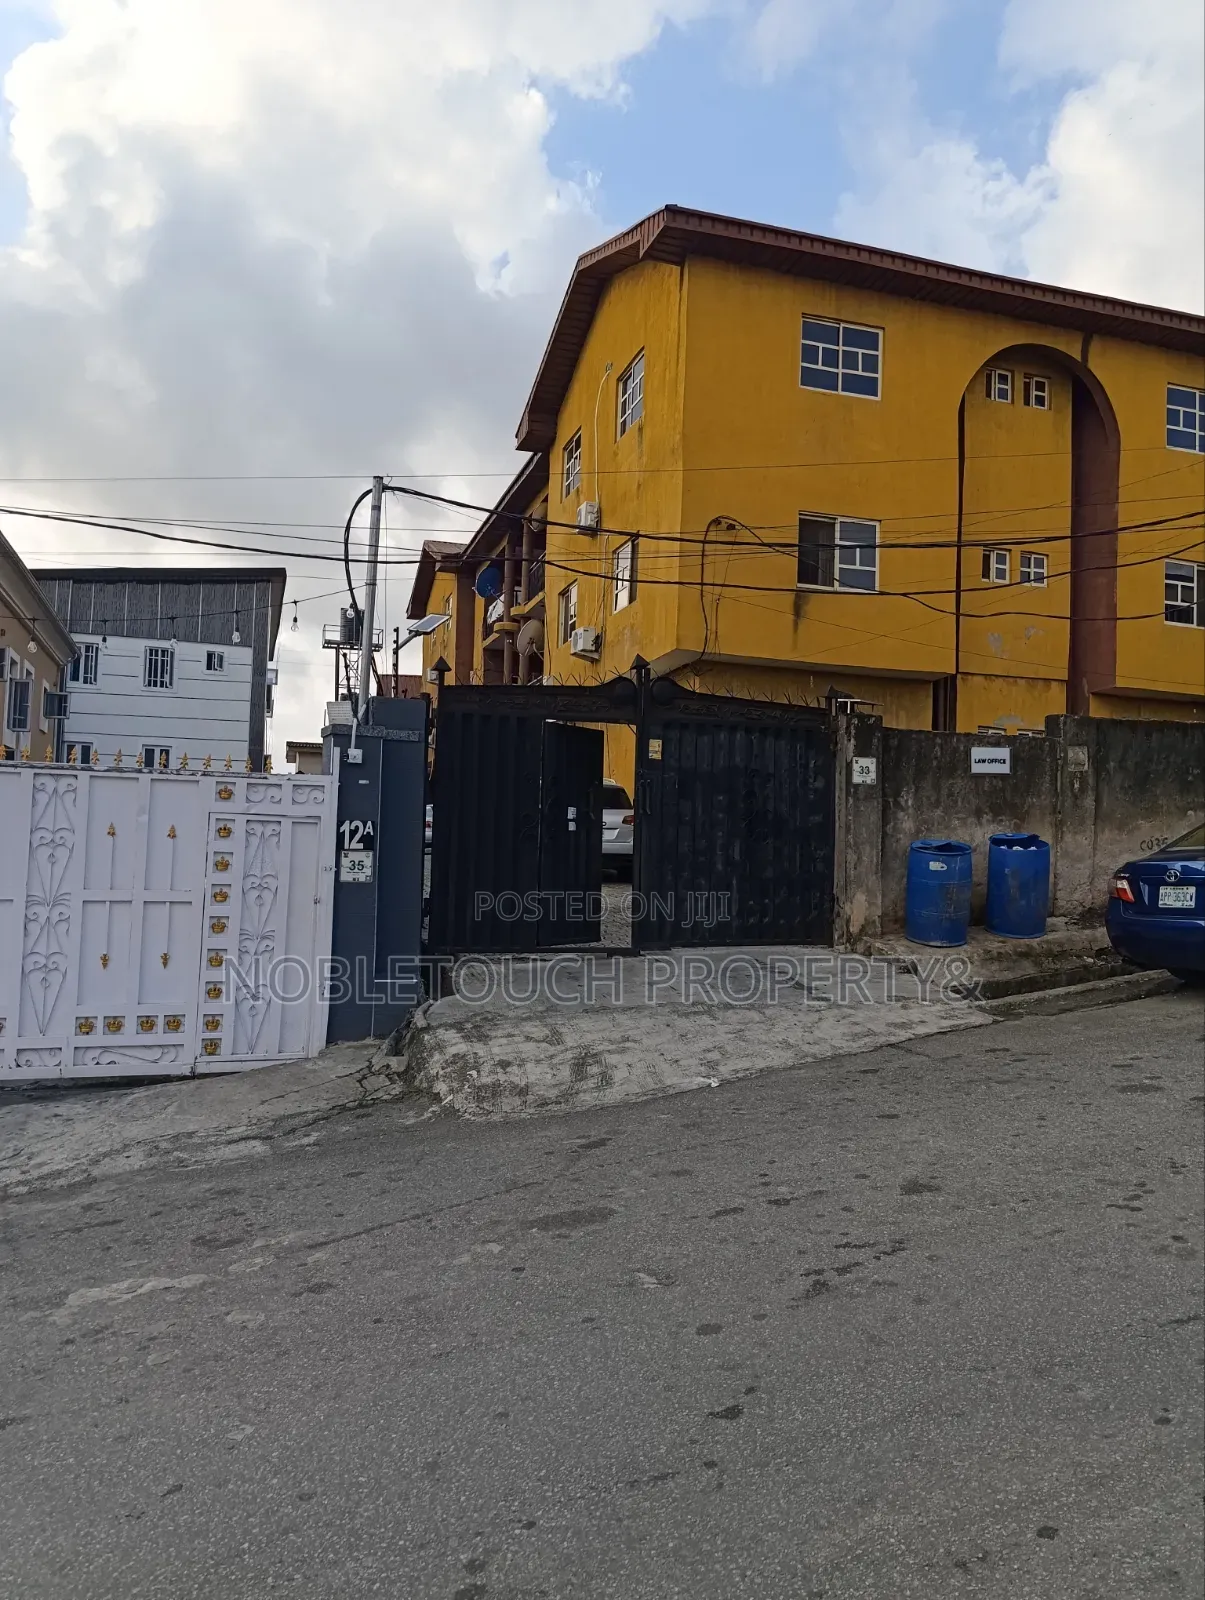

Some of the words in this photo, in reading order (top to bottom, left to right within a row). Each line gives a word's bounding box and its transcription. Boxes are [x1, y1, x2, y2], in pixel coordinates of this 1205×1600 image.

[858, 765, 870, 775] 33
[339, 820, 374, 849] 12A
[349, 860, 365, 871] 35
